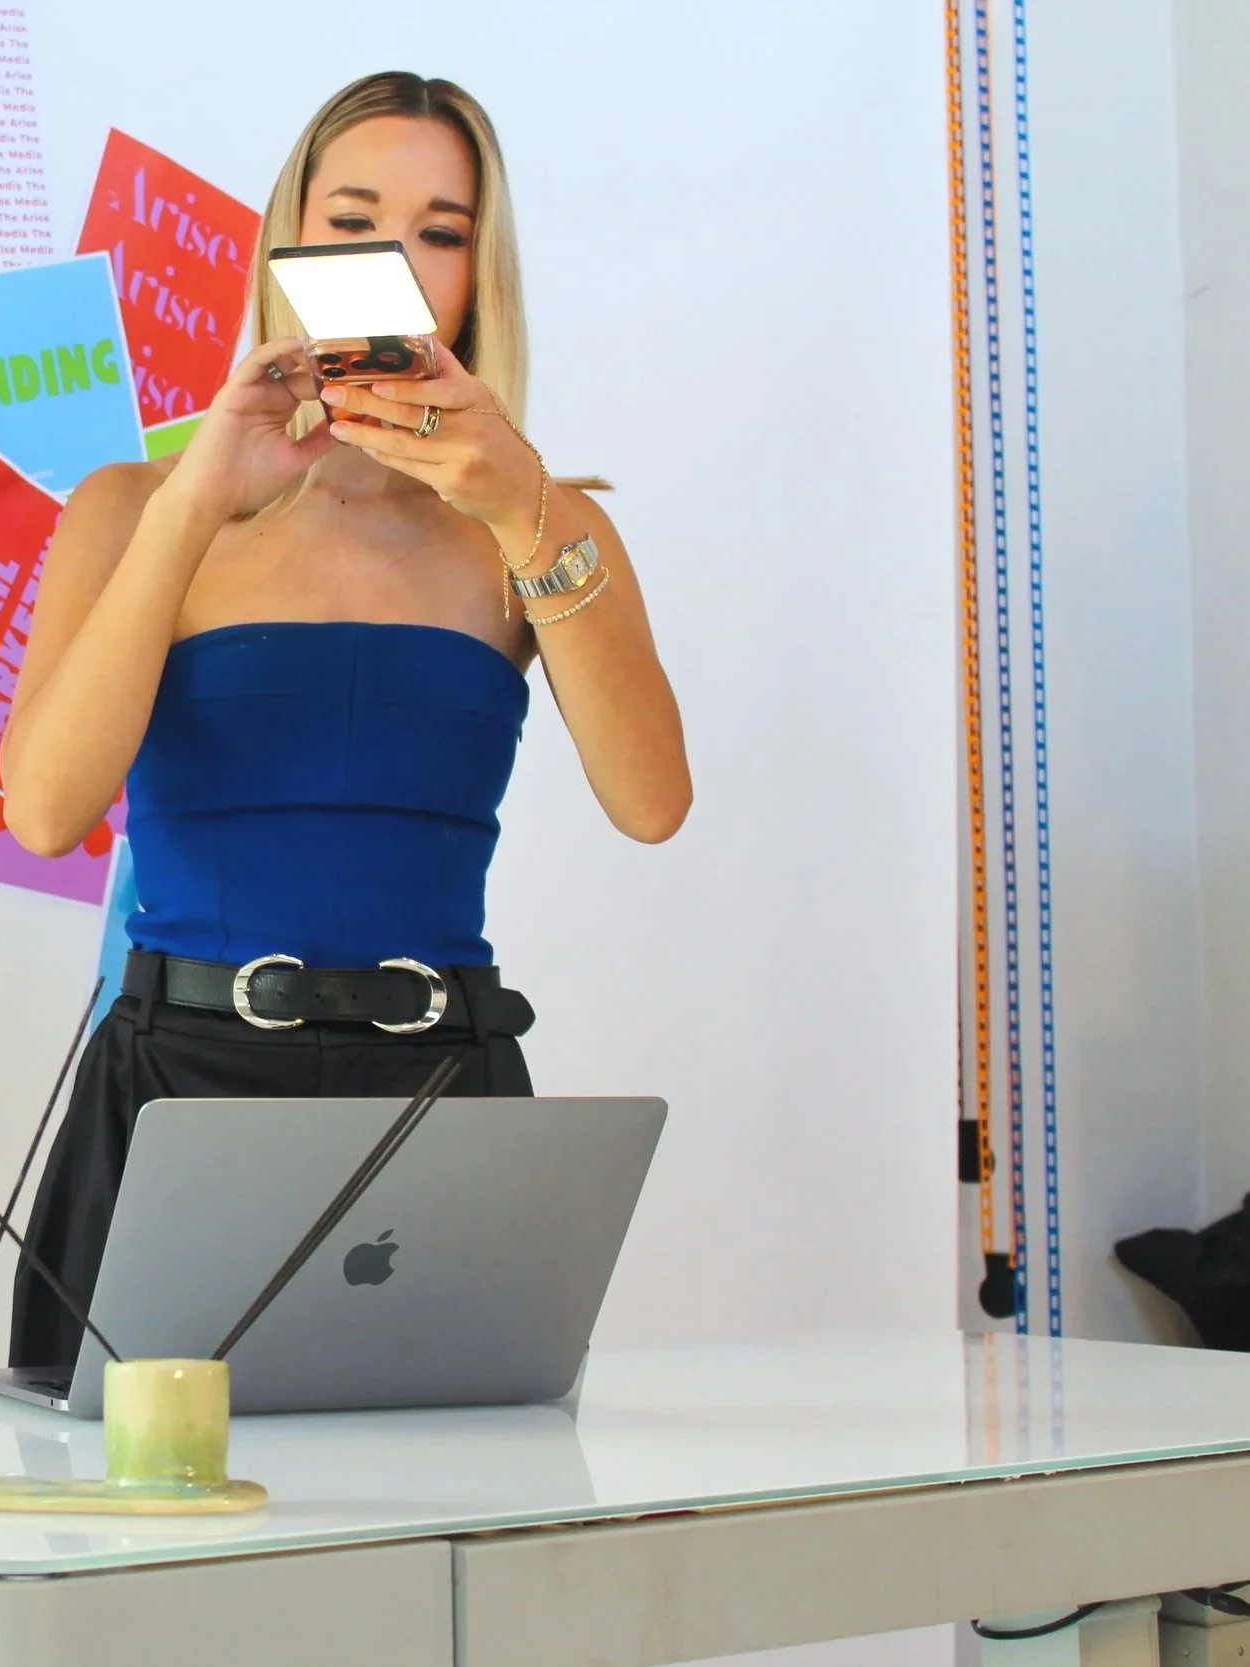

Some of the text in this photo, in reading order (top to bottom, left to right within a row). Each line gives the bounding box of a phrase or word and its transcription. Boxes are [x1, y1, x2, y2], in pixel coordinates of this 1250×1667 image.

[0, 23, 27, 33] Arise
[14, 87, 33, 96] The
[2, 103, 36, 112] Media
[8, 150, 42, 160] Media
[15, 166, 44, 175] Arise
[14, 197, 48, 207] Media
[22, 213, 50, 223] Arise
[109, 166, 237, 268] Arise
[31, 229, 52, 238] The
